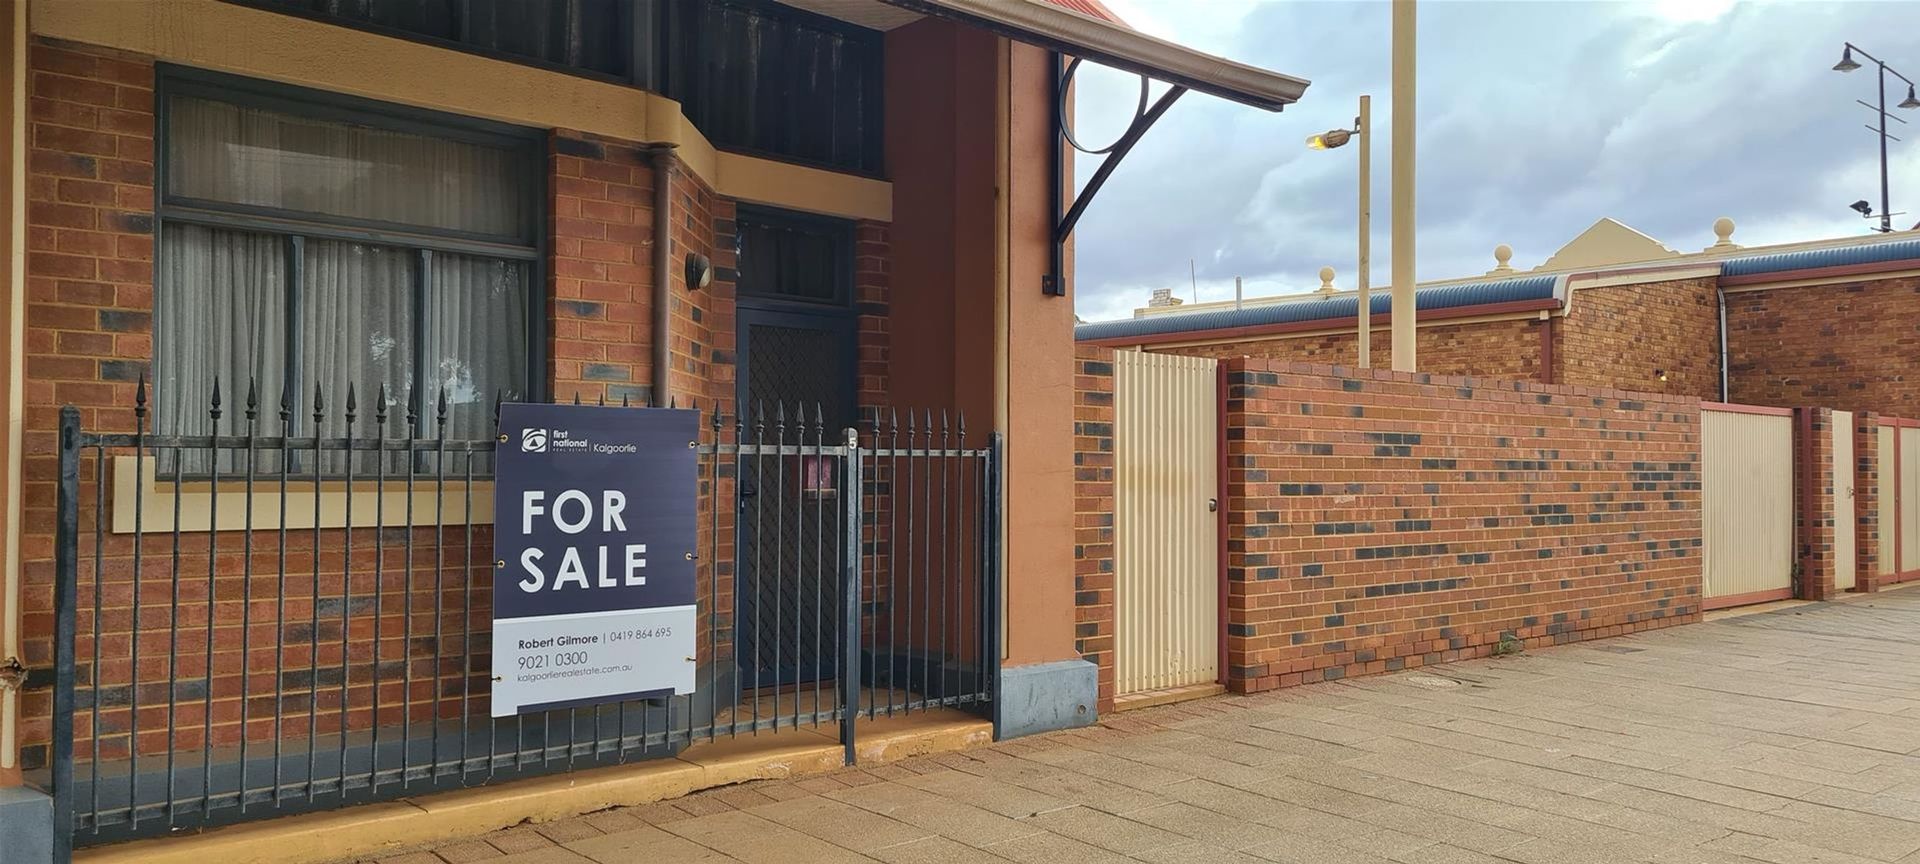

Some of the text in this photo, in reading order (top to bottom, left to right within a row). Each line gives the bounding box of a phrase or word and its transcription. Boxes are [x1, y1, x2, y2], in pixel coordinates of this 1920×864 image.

[553, 430, 568, 438] first
[553, 439, 588, 447] national
[849, 437, 857, 449] 5
[593, 443, 637, 454] Kalgoorlie
[522, 489, 627, 534] FOR
[518, 544, 647, 593] SALE
[518, 627, 672, 649] Robert Gilmore 0419 864 695
[517, 651, 588, 670] 9021 0300
[517, 664, 633, 682] kalgoorlierealestate.com.au
